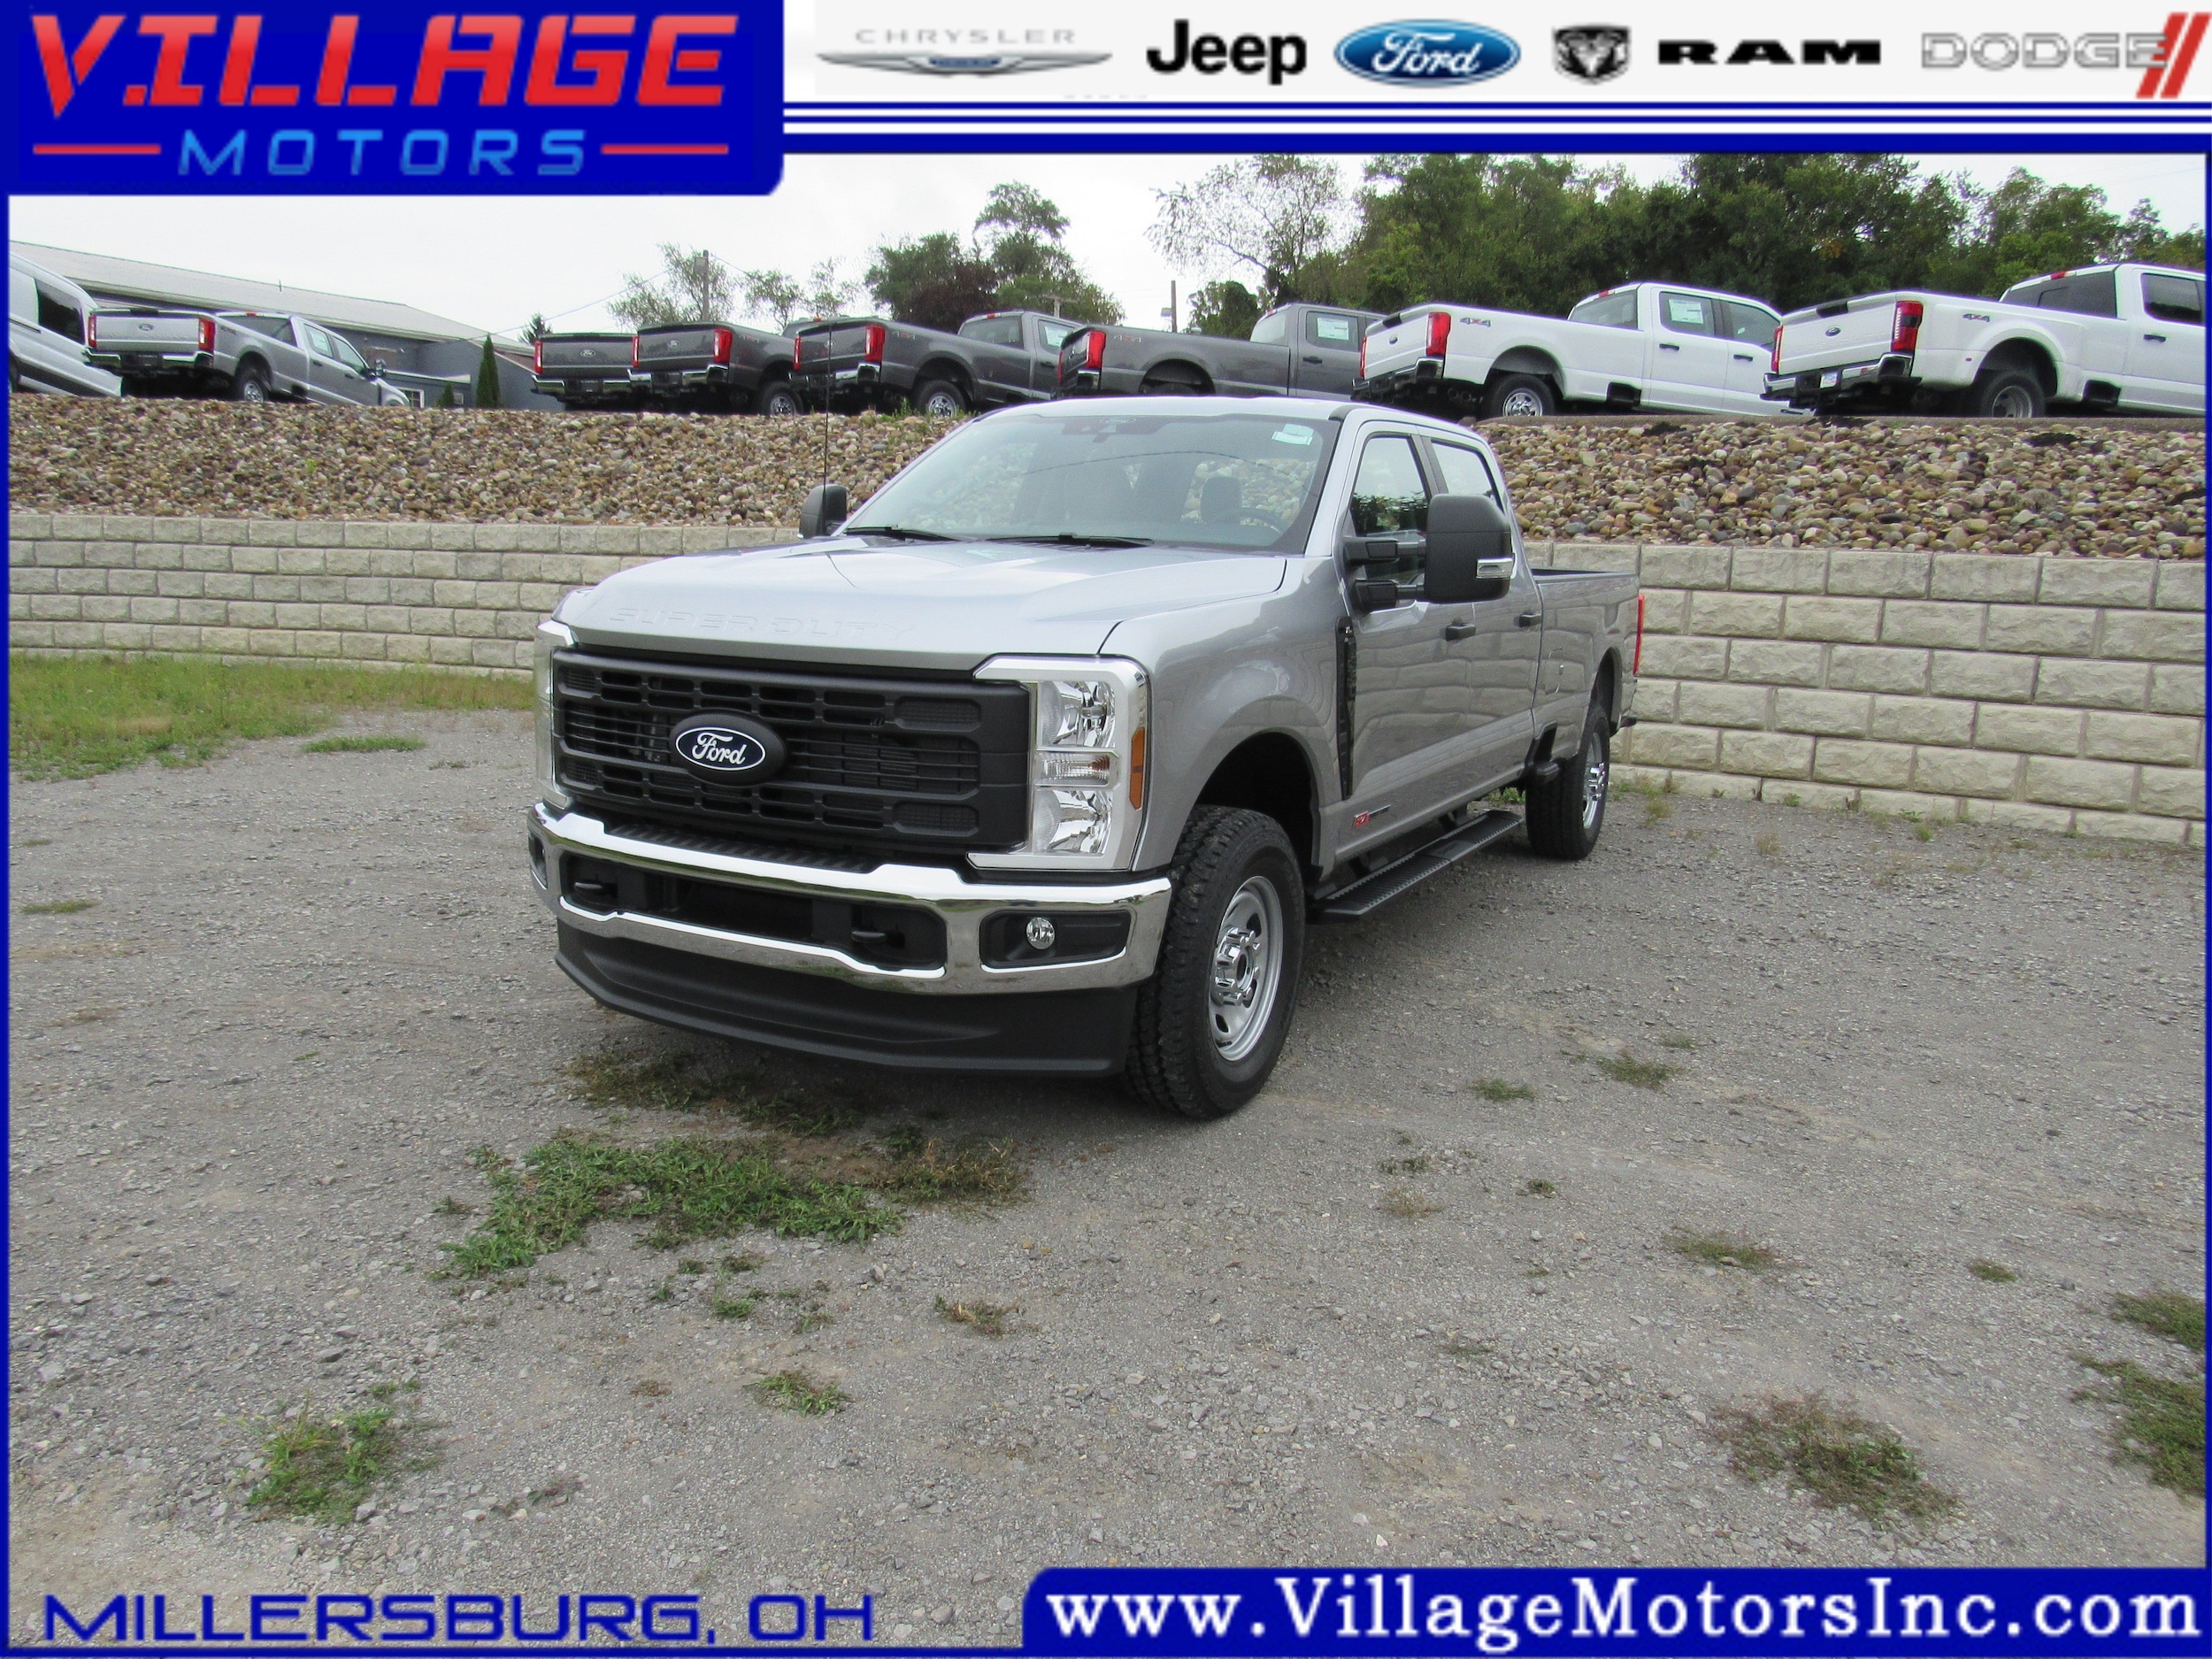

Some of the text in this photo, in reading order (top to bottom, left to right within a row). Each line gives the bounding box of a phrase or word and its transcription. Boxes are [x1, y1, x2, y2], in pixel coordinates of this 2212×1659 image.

[610, 608, 916, 640] SUPER DUTY
[691, 732, 747, 765] Ford
